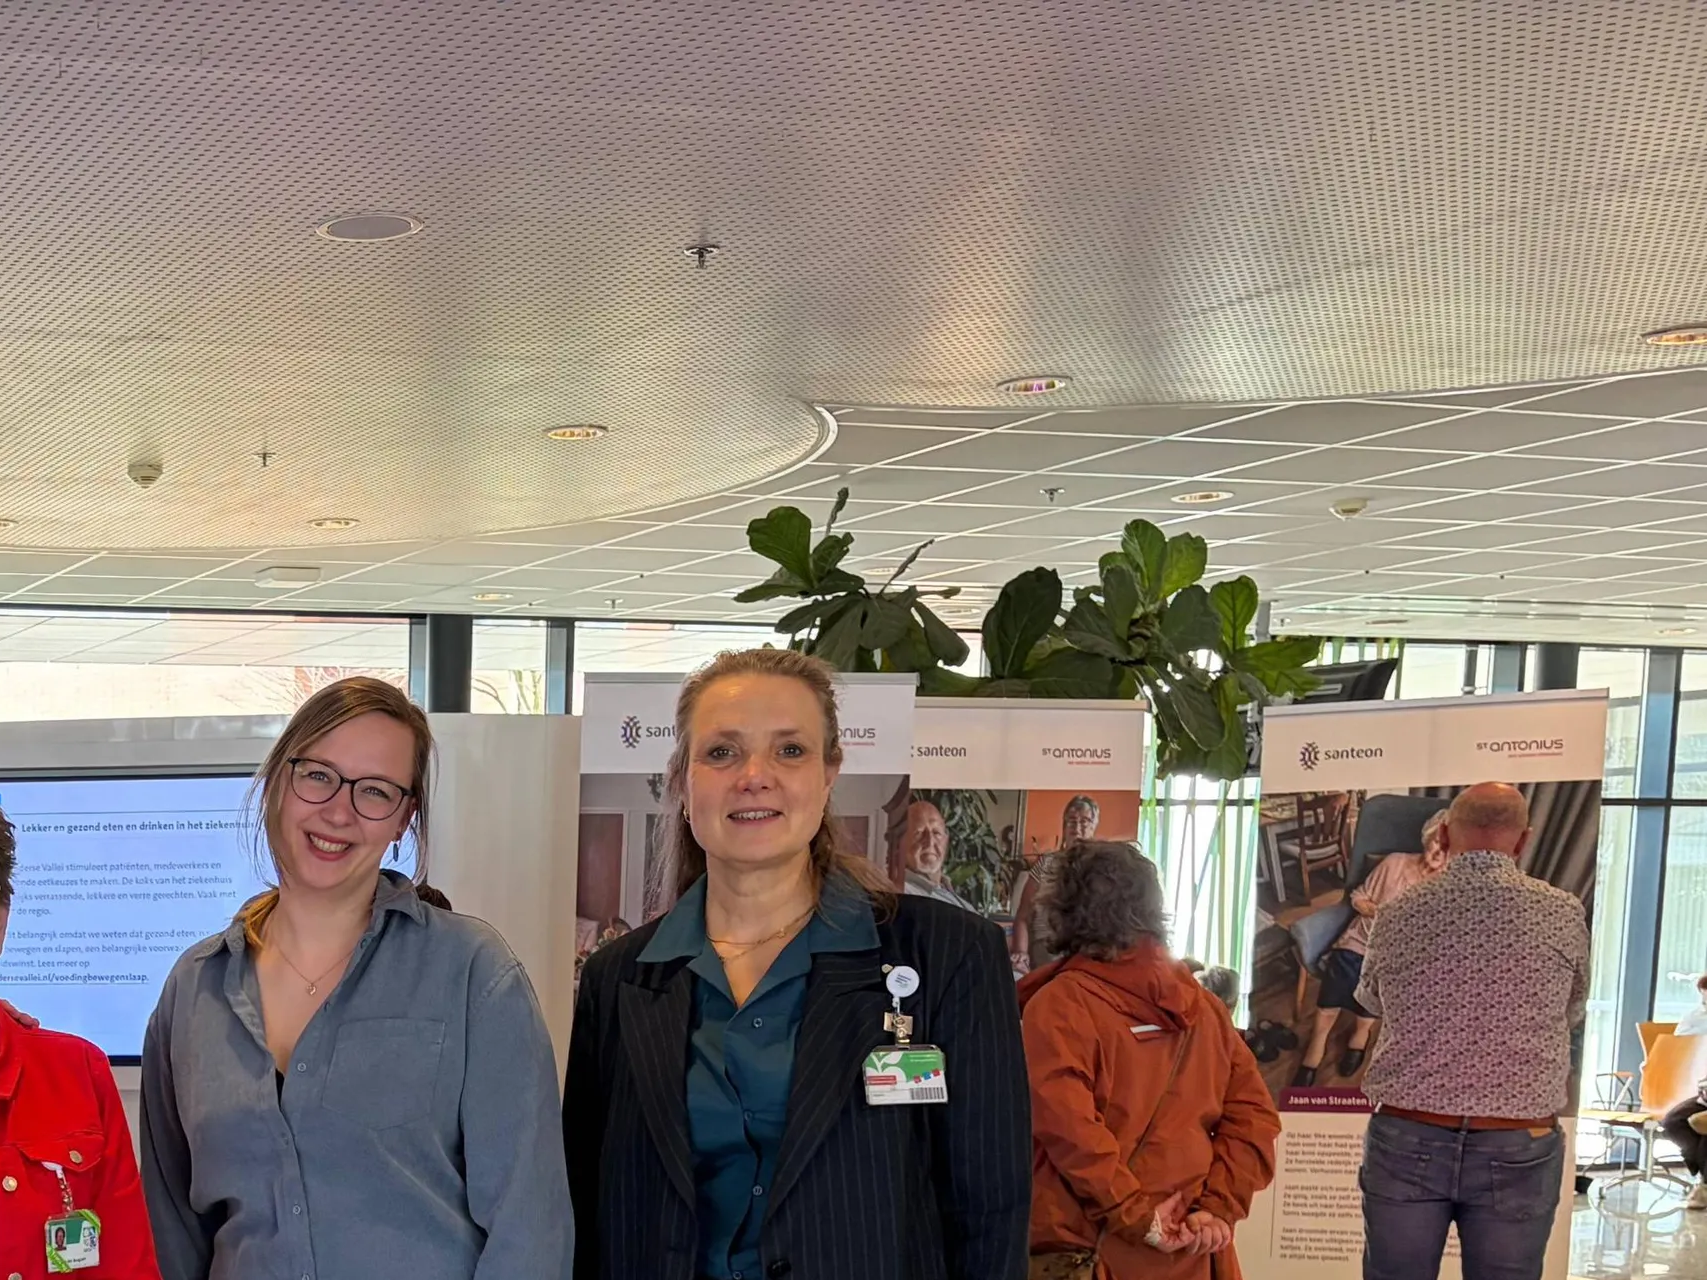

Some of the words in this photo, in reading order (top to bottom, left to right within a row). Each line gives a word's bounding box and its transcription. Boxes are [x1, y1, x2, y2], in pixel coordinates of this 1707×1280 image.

[646, 725, 676, 738] sant
[916, 744, 967, 758] santeon
[1324, 745, 1383, 761] santeon
[21, 823, 52, 832] Lekker
[53, 824, 65, 832] en
[66, 822, 101, 834] gezond
[102, 822, 124, 831] eten
[125, 823, 137, 831] en
[139, 820, 174, 831] drinken
[176, 820, 185, 830] in
[187, 820, 203, 830] het
[122, 876, 134, 885] De
[154, 877, 171, 885] van
[172, 876, 186, 885] het
[129, 930, 143, 938] dat
[1288, 1095, 1310, 1105] Jaan
[1310, 1097, 1328, 1105] van
[1328, 1096, 1368, 1106] Straaten
